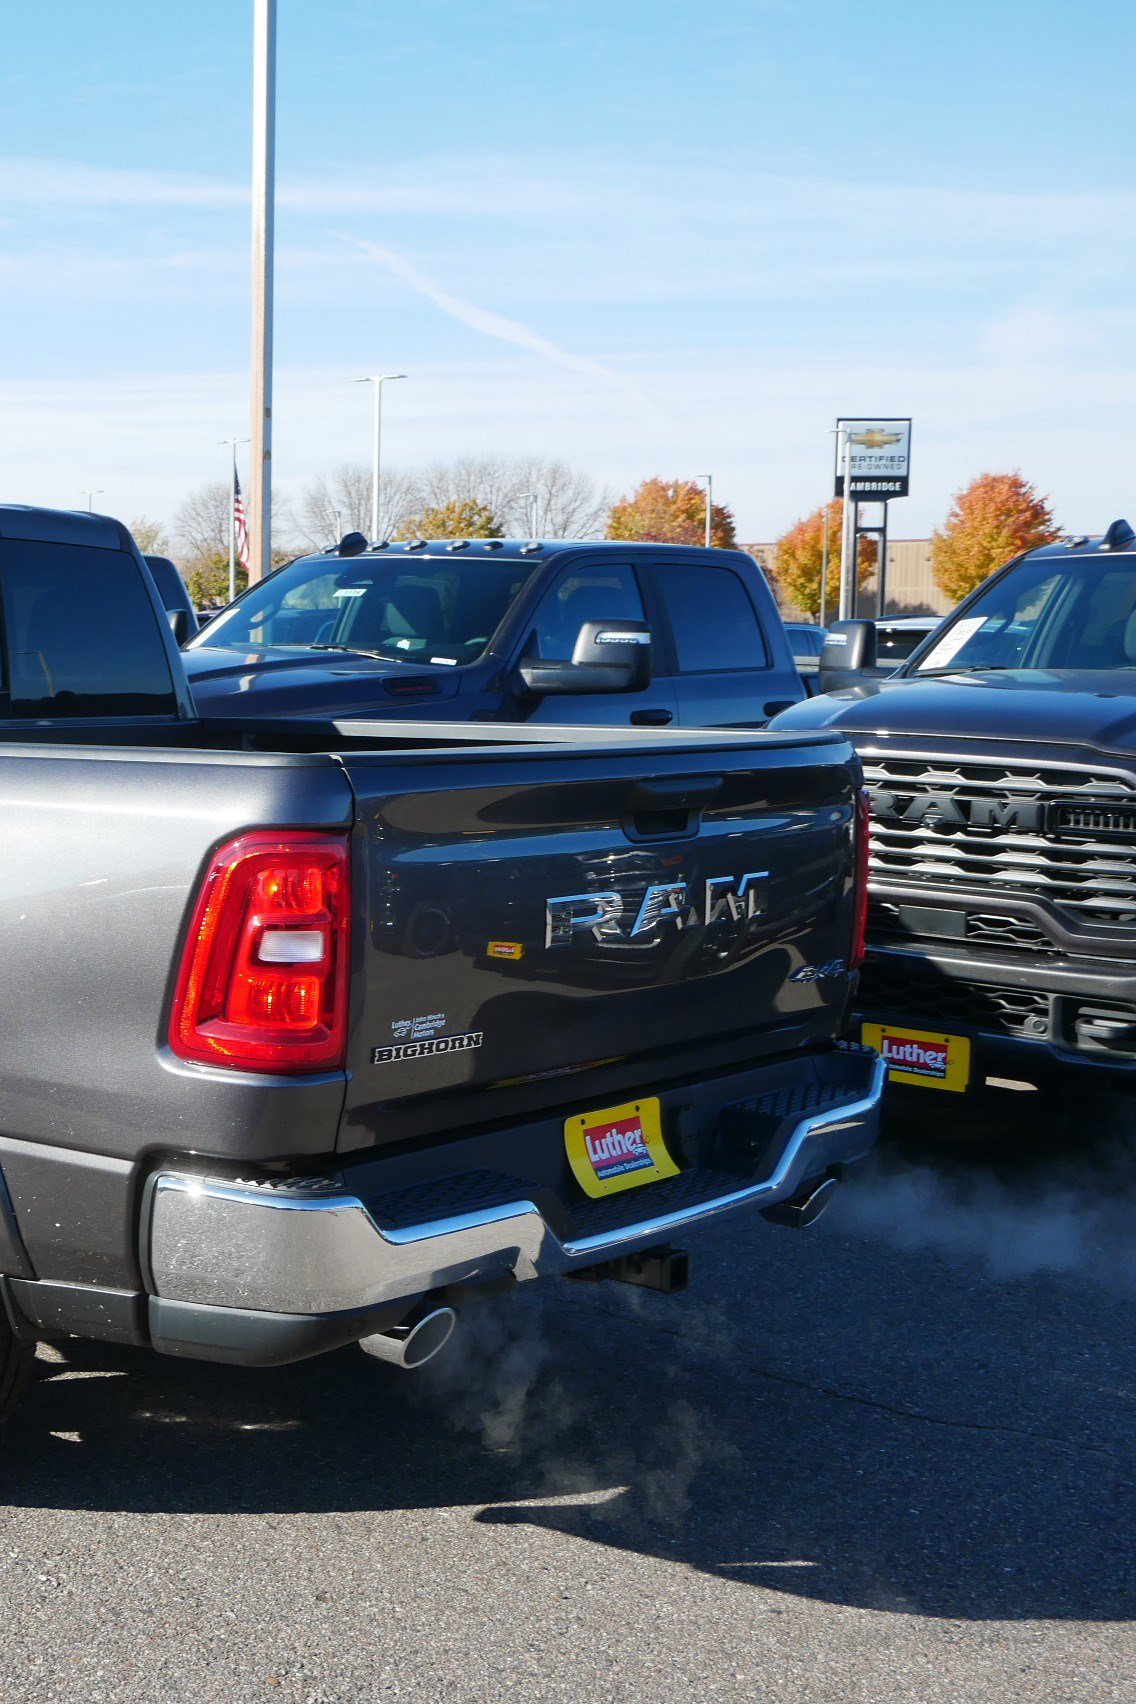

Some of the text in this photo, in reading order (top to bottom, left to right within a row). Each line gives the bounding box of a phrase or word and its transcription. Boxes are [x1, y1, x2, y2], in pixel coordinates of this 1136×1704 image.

[843, 481, 902, 491] AMBRIDGE
[545, 870, 769, 950] RAM
[373, 1032, 484, 1064] BIGHORN
[883, 1039, 947, 1064] Luther
[585, 1128, 642, 1163] Luther
